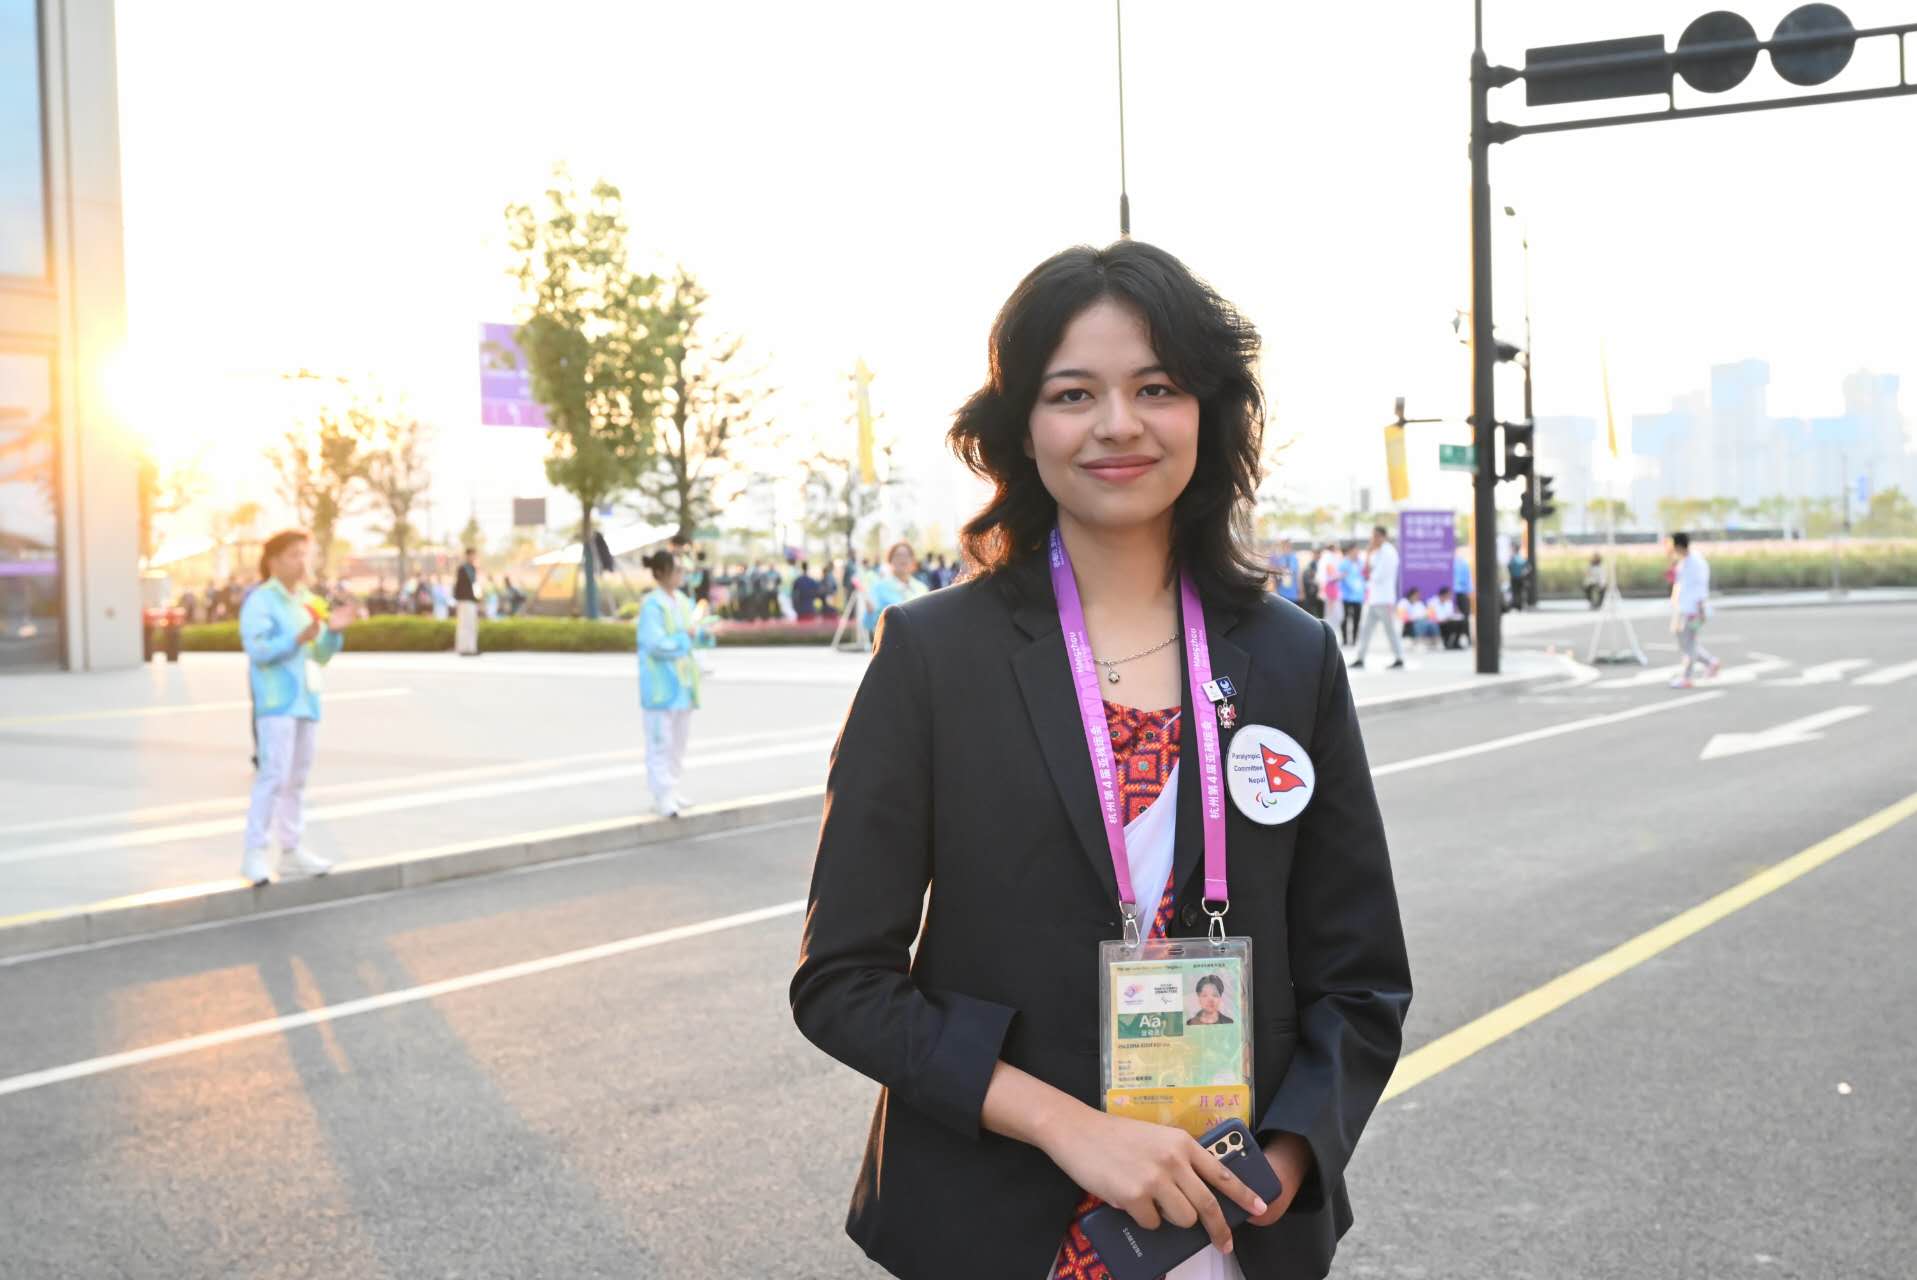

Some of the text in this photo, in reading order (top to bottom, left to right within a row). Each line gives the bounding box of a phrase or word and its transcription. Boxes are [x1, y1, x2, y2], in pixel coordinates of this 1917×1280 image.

[1232, 752, 1261, 761] Paralympic
[1248, 777, 1265, 785] Nepal
[1139, 1015, 1161, 1028] Aa
[1122, 1227, 1143, 1258] SAMSUNG
